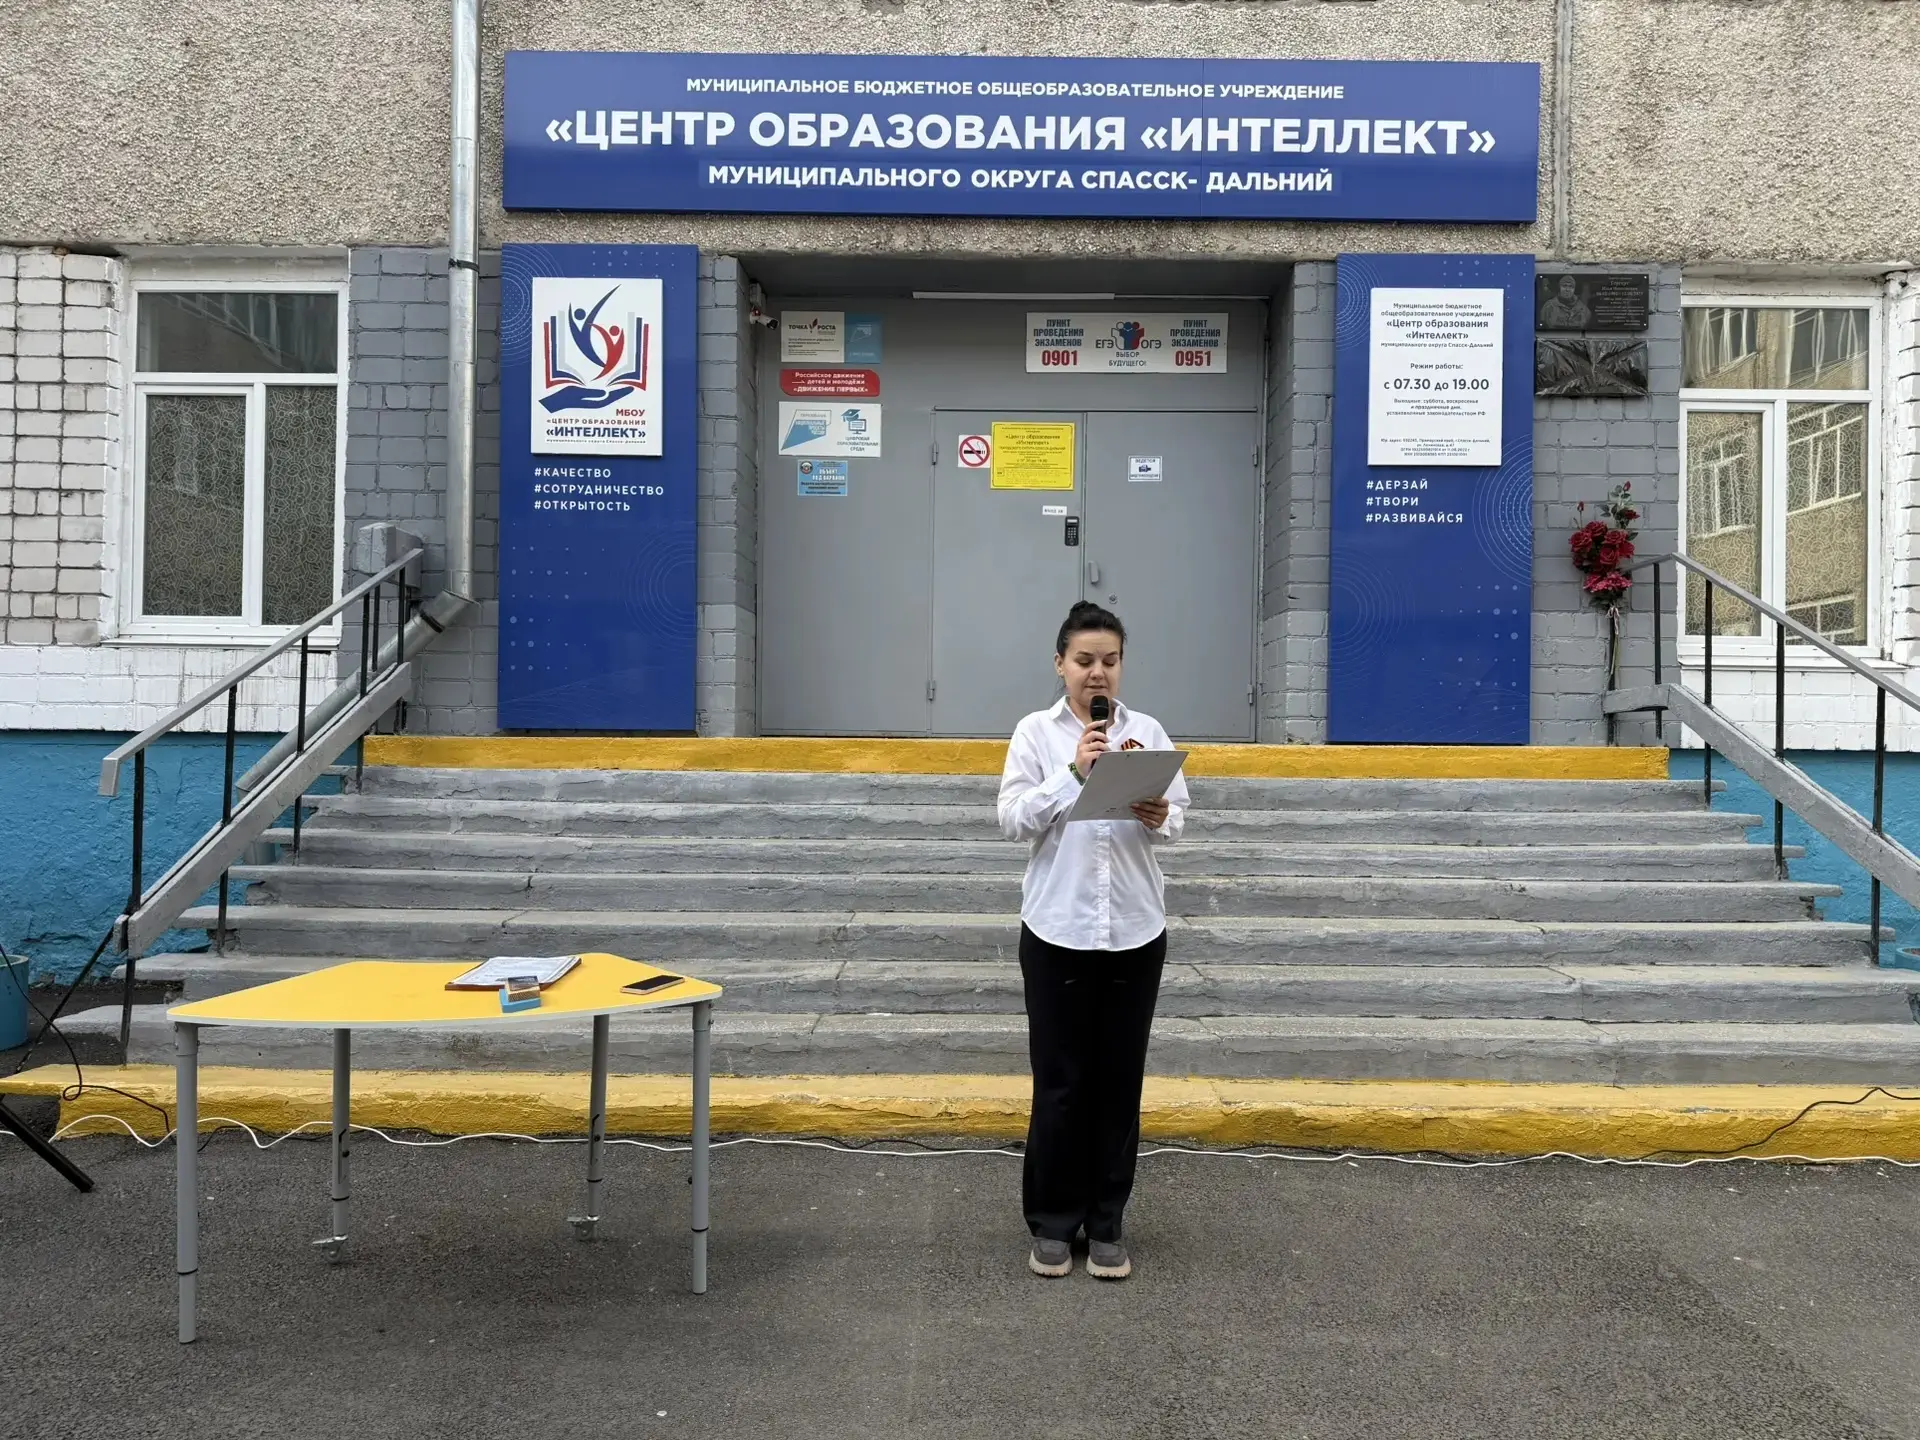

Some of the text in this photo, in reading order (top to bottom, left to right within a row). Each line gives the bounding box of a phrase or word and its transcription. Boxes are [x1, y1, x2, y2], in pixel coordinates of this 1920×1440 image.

[686, 78, 1344, 100] МУНИЦИПАЛЬНОЕ БЮДЖЕТНОЕ ОБЩЕОБРАЗОВАТЕЛЬНОЕ УЧРЕЖДЕНИЕ
[545, 110, 1496, 155] «ЦЕНТР ОБРАЗОВАНИЯ «ИНТЕЛЛЕКТ»
[708, 165, 1333, 194] МУНИЦИПАЛЬНОГО ОКРУГА СПАССК- ДАЛЬНИЙ
[1183, 320, 1208, 328] ПУНКТ
[1386, 319, 1488, 328] «Центр образования
[1033, 328, 1084, 337] ПРОВЕДЕНИЯ
[1170, 329, 1220, 338] ПРОВЕДЕНИЯ
[1406, 331, 1468, 340] «Интеллект»
[1035, 339, 1082, 347] ЭКЗАМЕНОВ
[1096, 339, 1161, 349] ЕГЭ ОГЭ
[1171, 339, 1218, 348] ЭКЗАМЕНОВ
[1042, 350, 1078, 366] 0901
[1175, 350, 1211, 366] 0951
[1384, 378, 1489, 391] с 07.30 до 19.00
[616, 408, 646, 416] МБОУ
[546, 426, 646, 438] «ИНТЕЛЛЕКТ»
[534, 467, 612, 478] #КАЧЕСТВО
[1366, 478, 1428, 490] #ДЕРЗАЙ
[534, 484, 664, 496] #СОТРУДНИЧЕСТВО
[534, 500, 630, 511] #ОТКРЫТОСТЬ
[1366, 497, 1419, 506] #ТВОРИ
[1366, 512, 1463, 522] #РАЗВИВАЙСЯ
